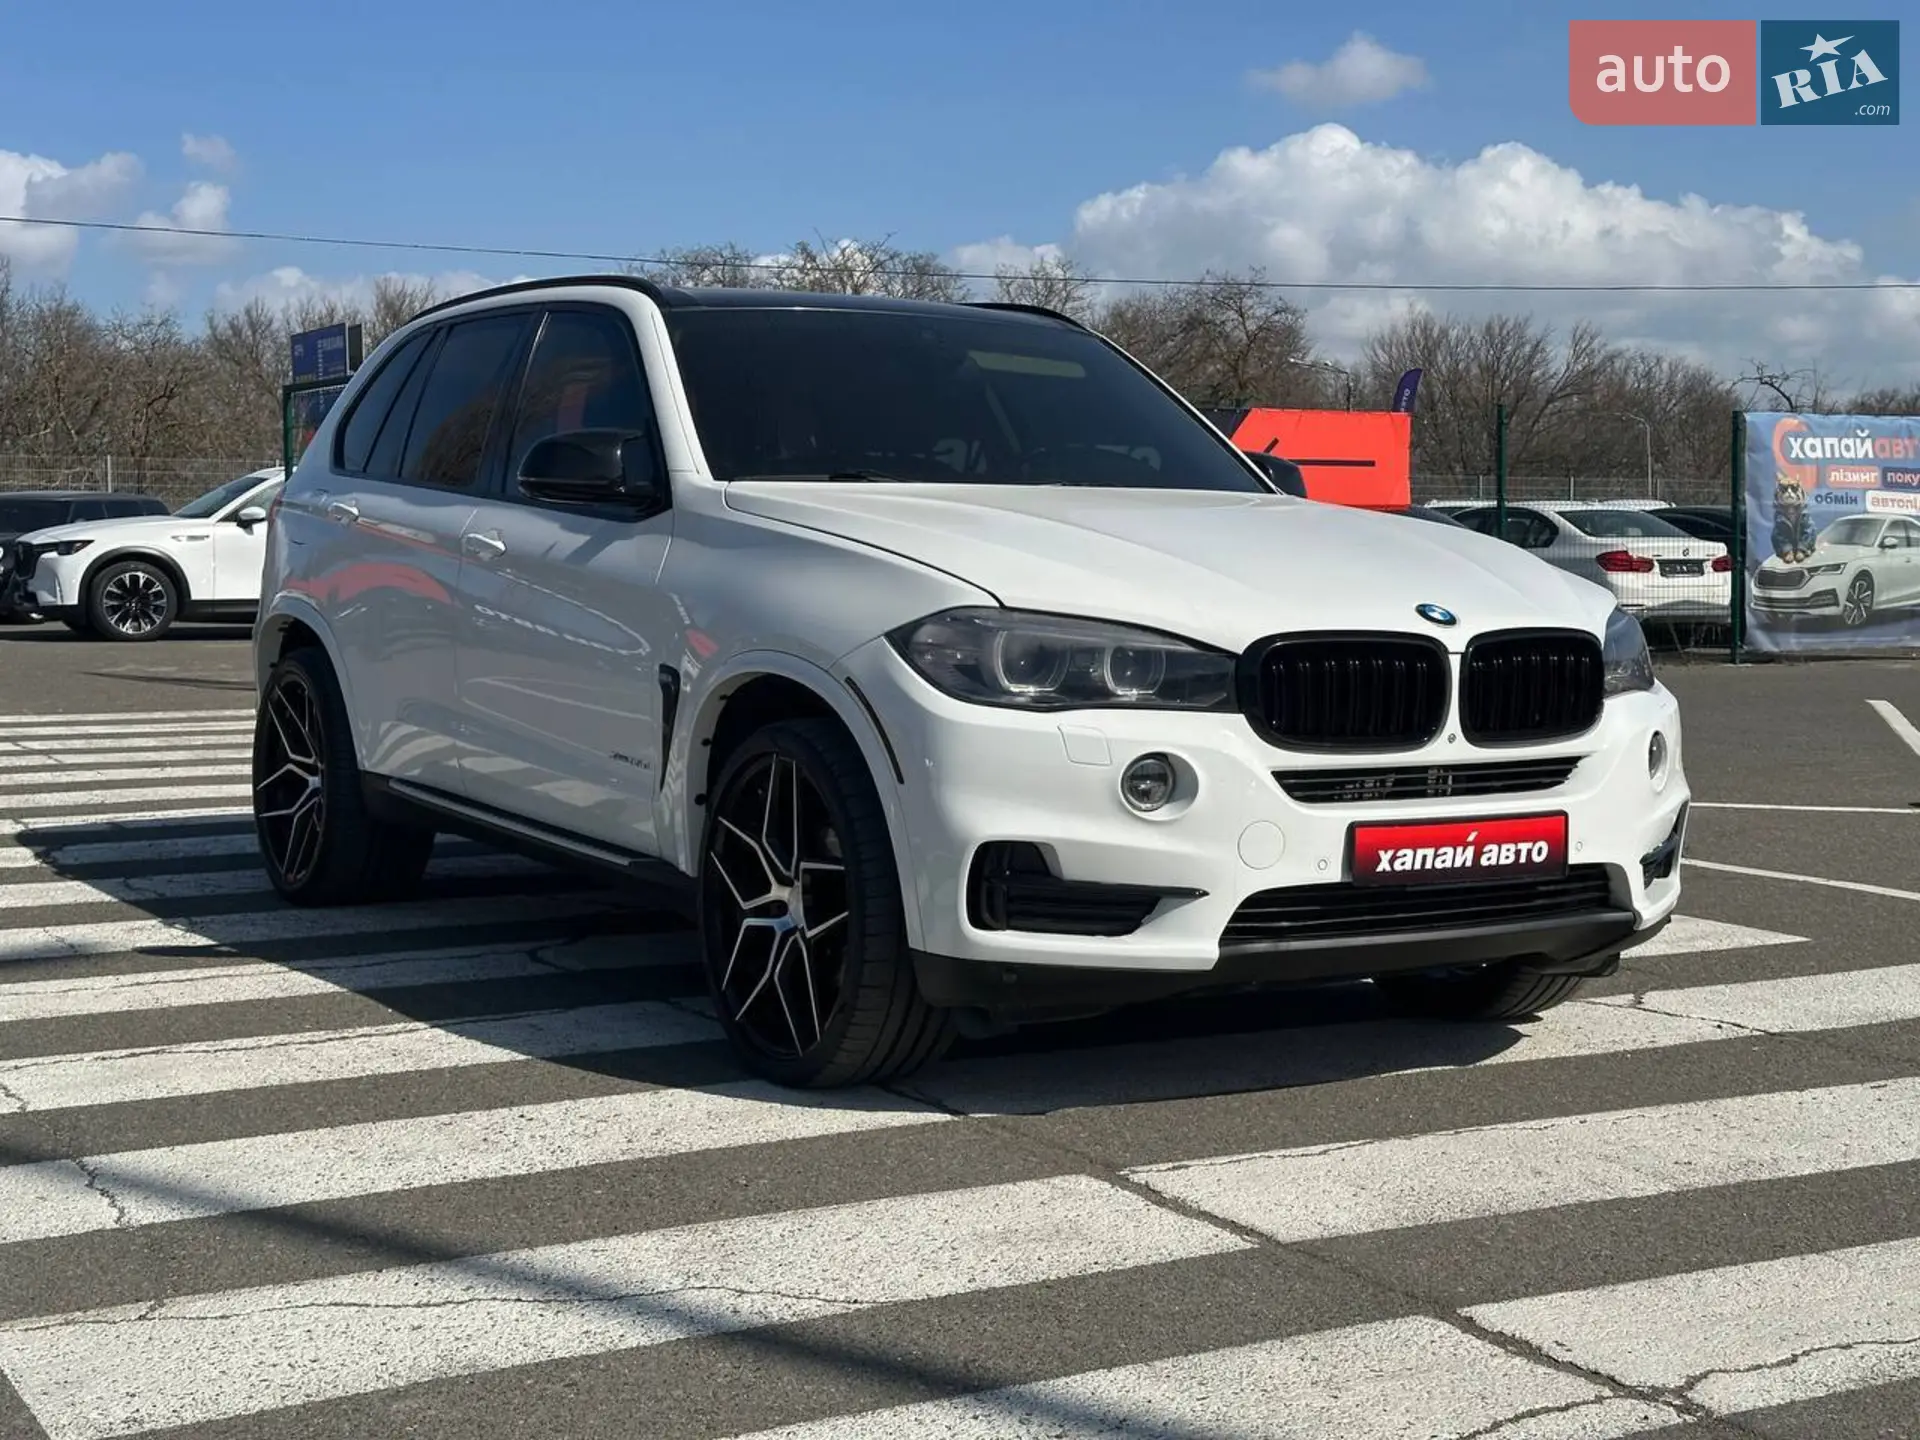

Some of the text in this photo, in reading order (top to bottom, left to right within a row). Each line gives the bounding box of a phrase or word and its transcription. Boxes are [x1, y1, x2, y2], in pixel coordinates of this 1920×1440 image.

[1814, 492, 1858, 505] обмін
[1871, 497, 1920, 510] автопі
[1375, 831, 1549, 873] хапай авто
